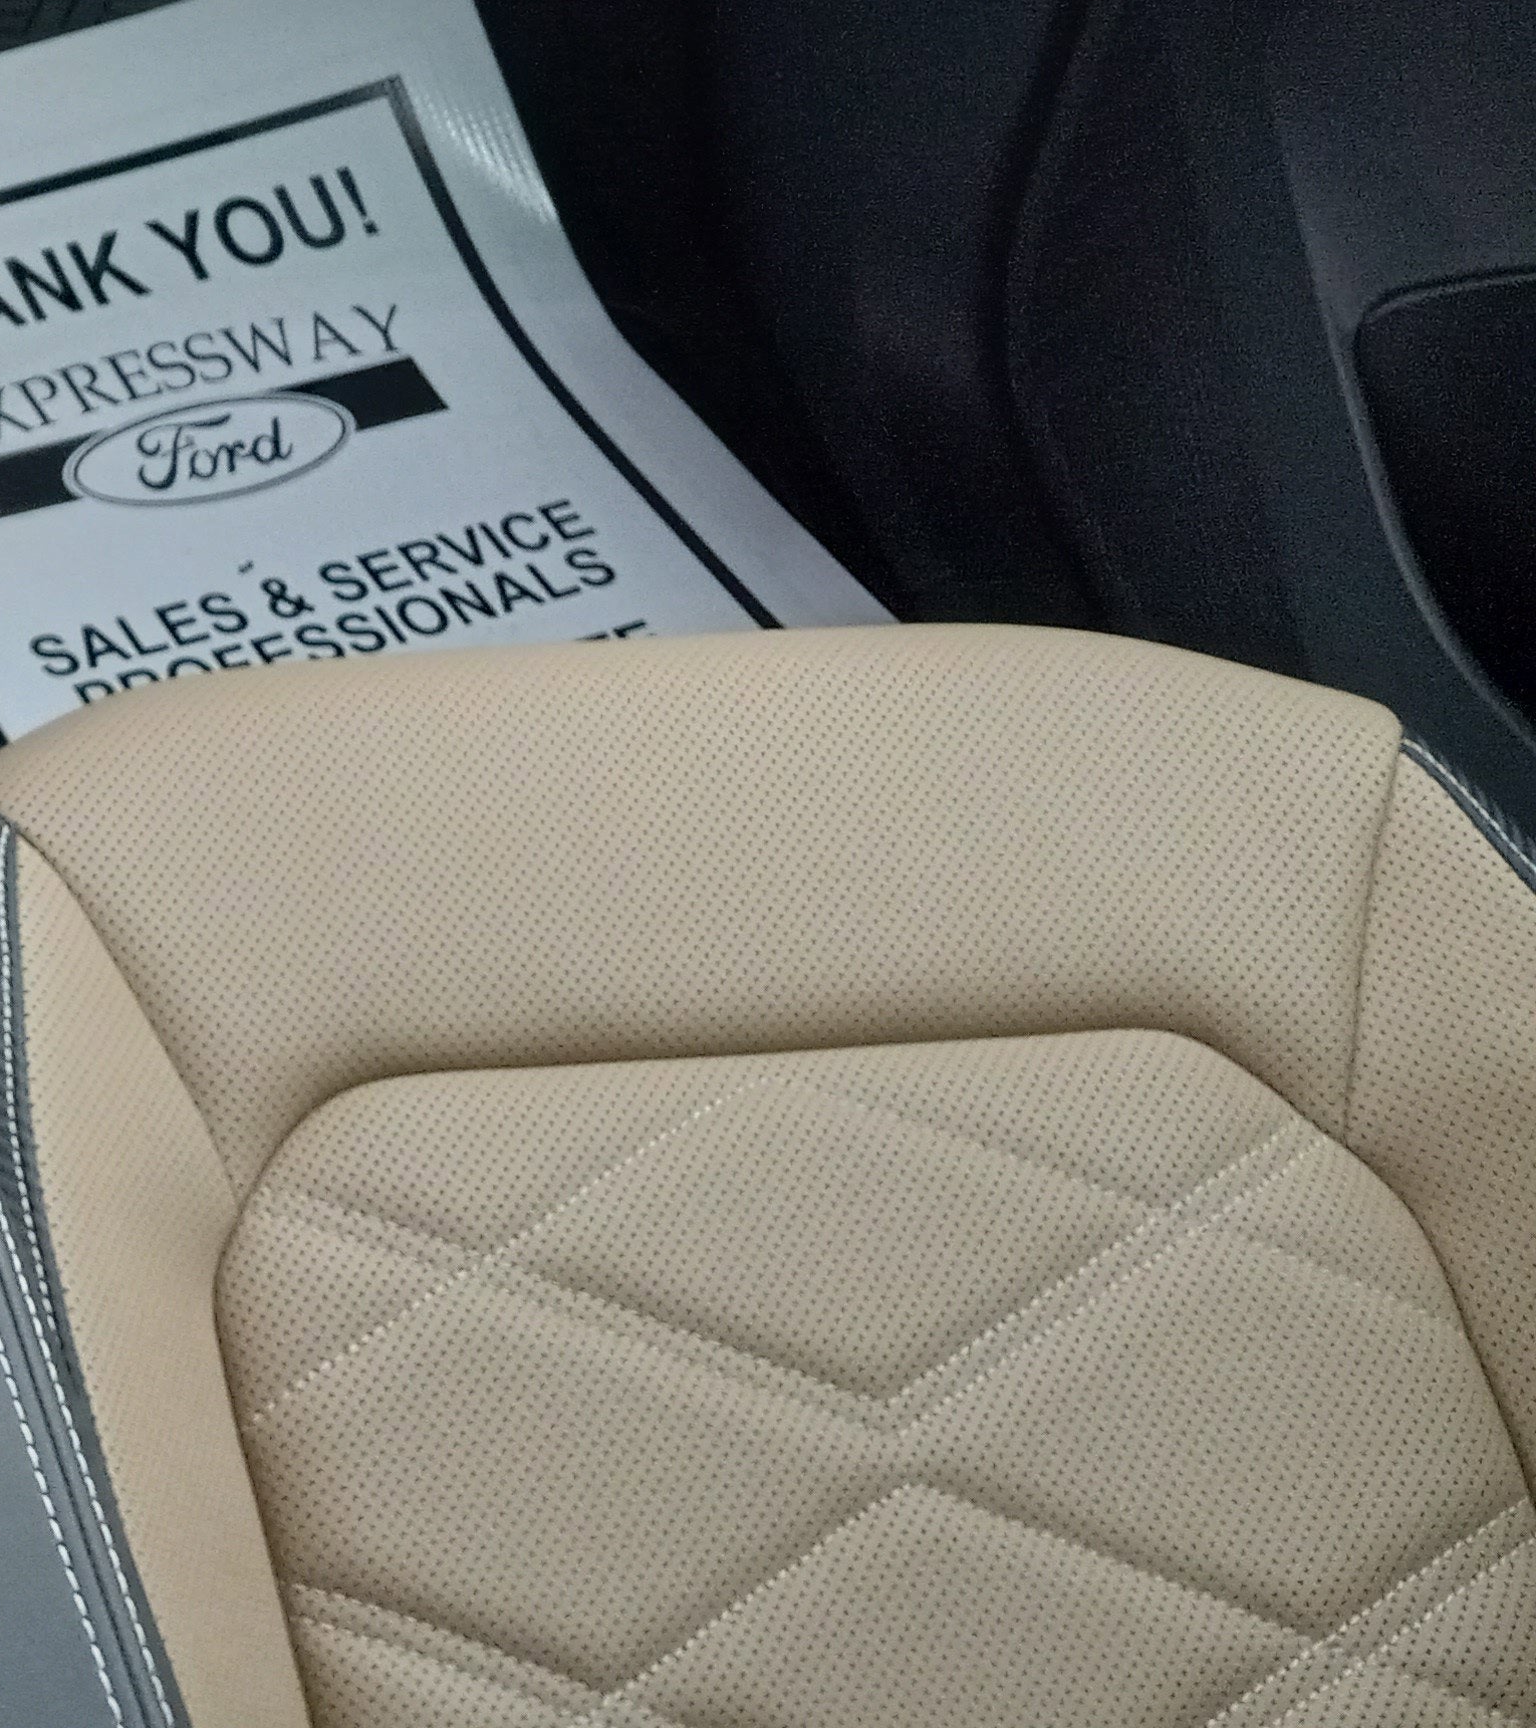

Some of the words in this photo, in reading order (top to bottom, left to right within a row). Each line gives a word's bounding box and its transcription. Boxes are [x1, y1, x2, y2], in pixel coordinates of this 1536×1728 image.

[145, 166, 381, 281] YOU!
[136, 415, 293, 492] Ford
[29, 591, 249, 677] SALES
[259, 576, 315, 619] &
[320, 497, 597, 603] SERVICE
